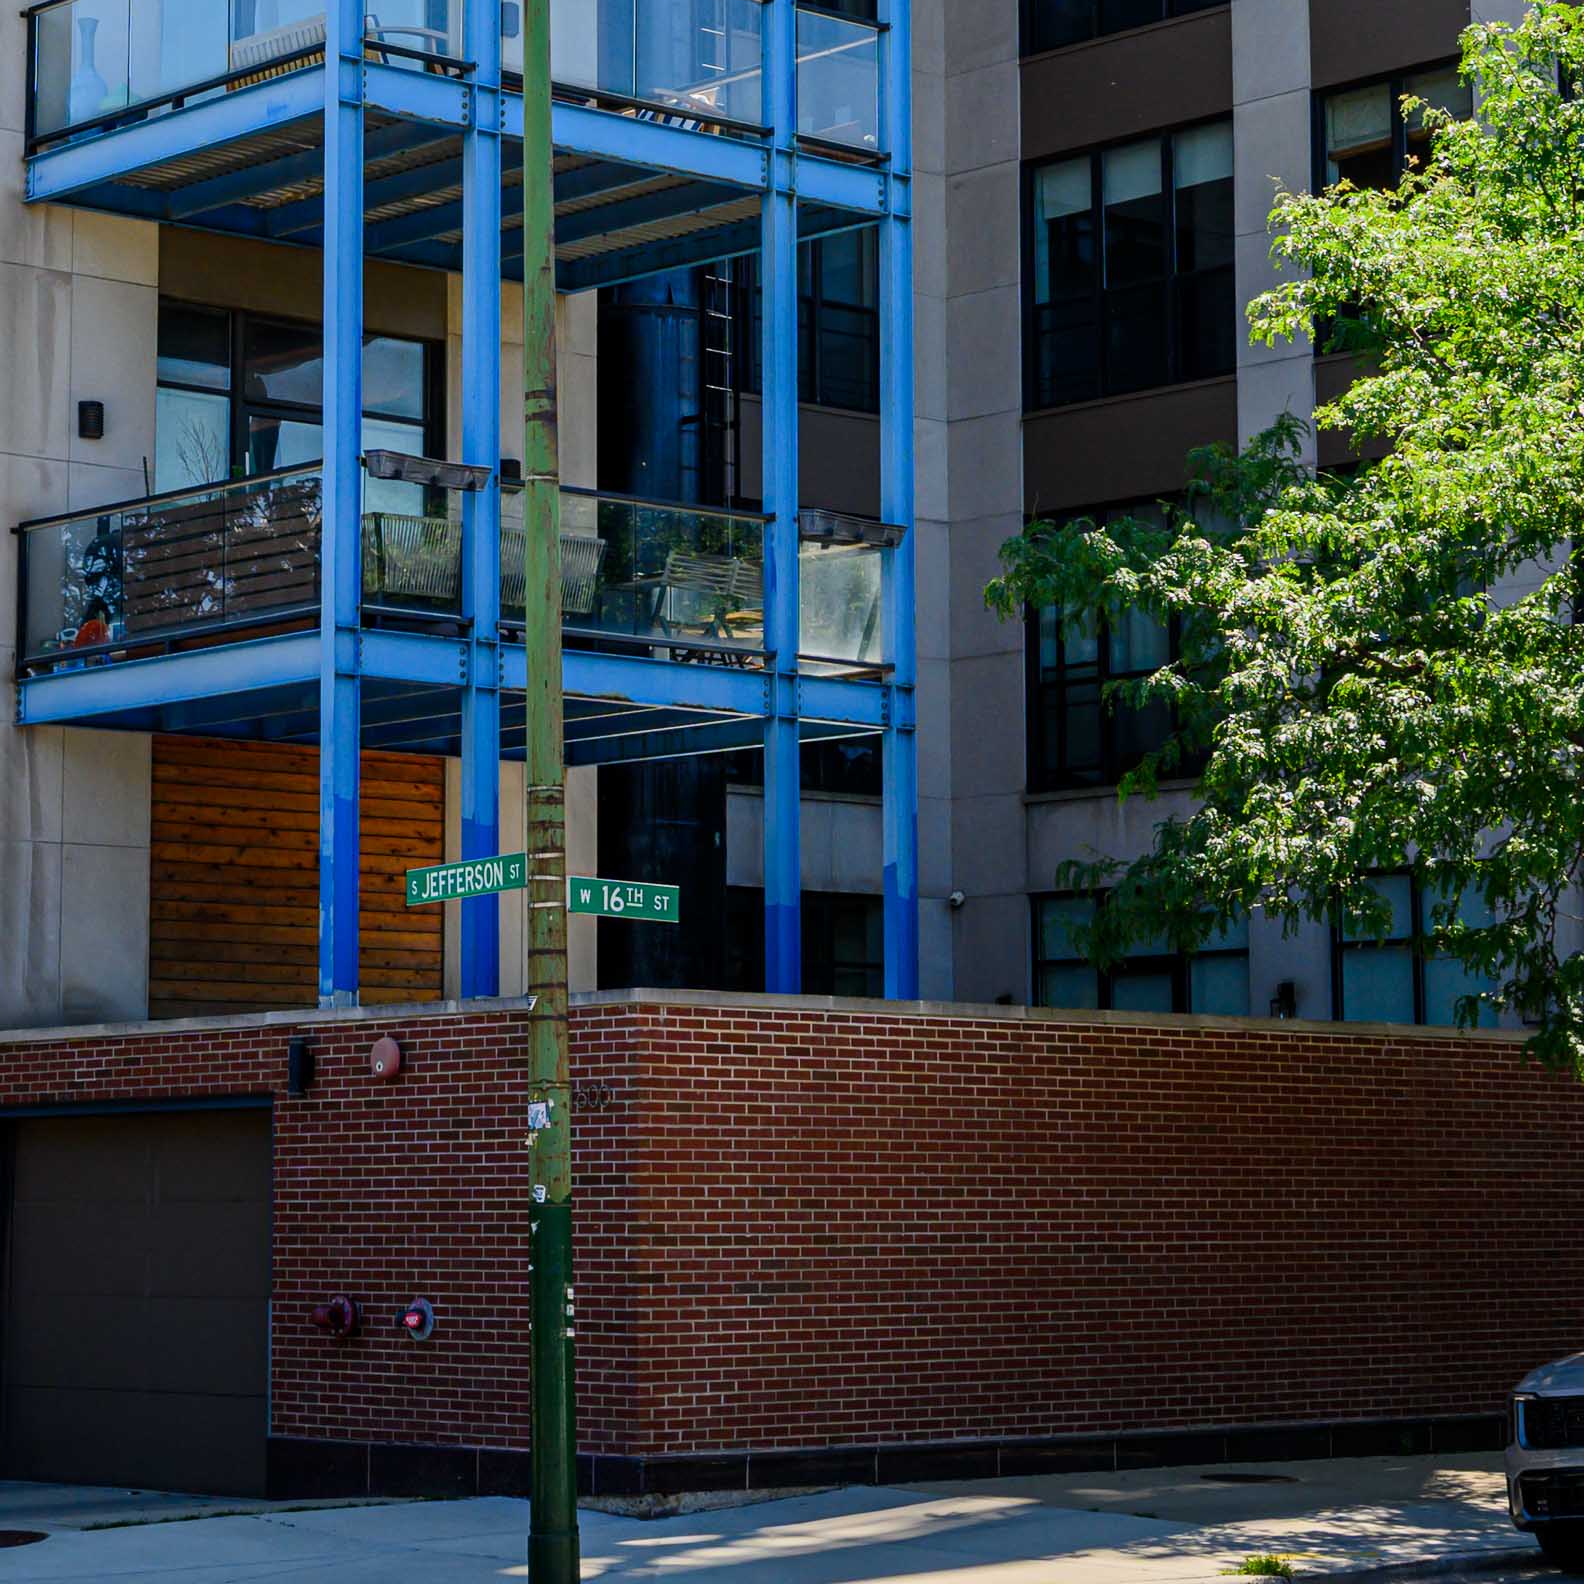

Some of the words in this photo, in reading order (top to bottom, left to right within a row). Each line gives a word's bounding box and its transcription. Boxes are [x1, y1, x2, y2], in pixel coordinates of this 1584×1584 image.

[411, 880, 417, 895] S
[421, 861, 504, 899] JEFFERSON
[509, 863, 520, 880] ST
[580, 888, 591, 904] W
[602, 885, 644, 912] 16TH
[653, 895, 670, 911] ST
